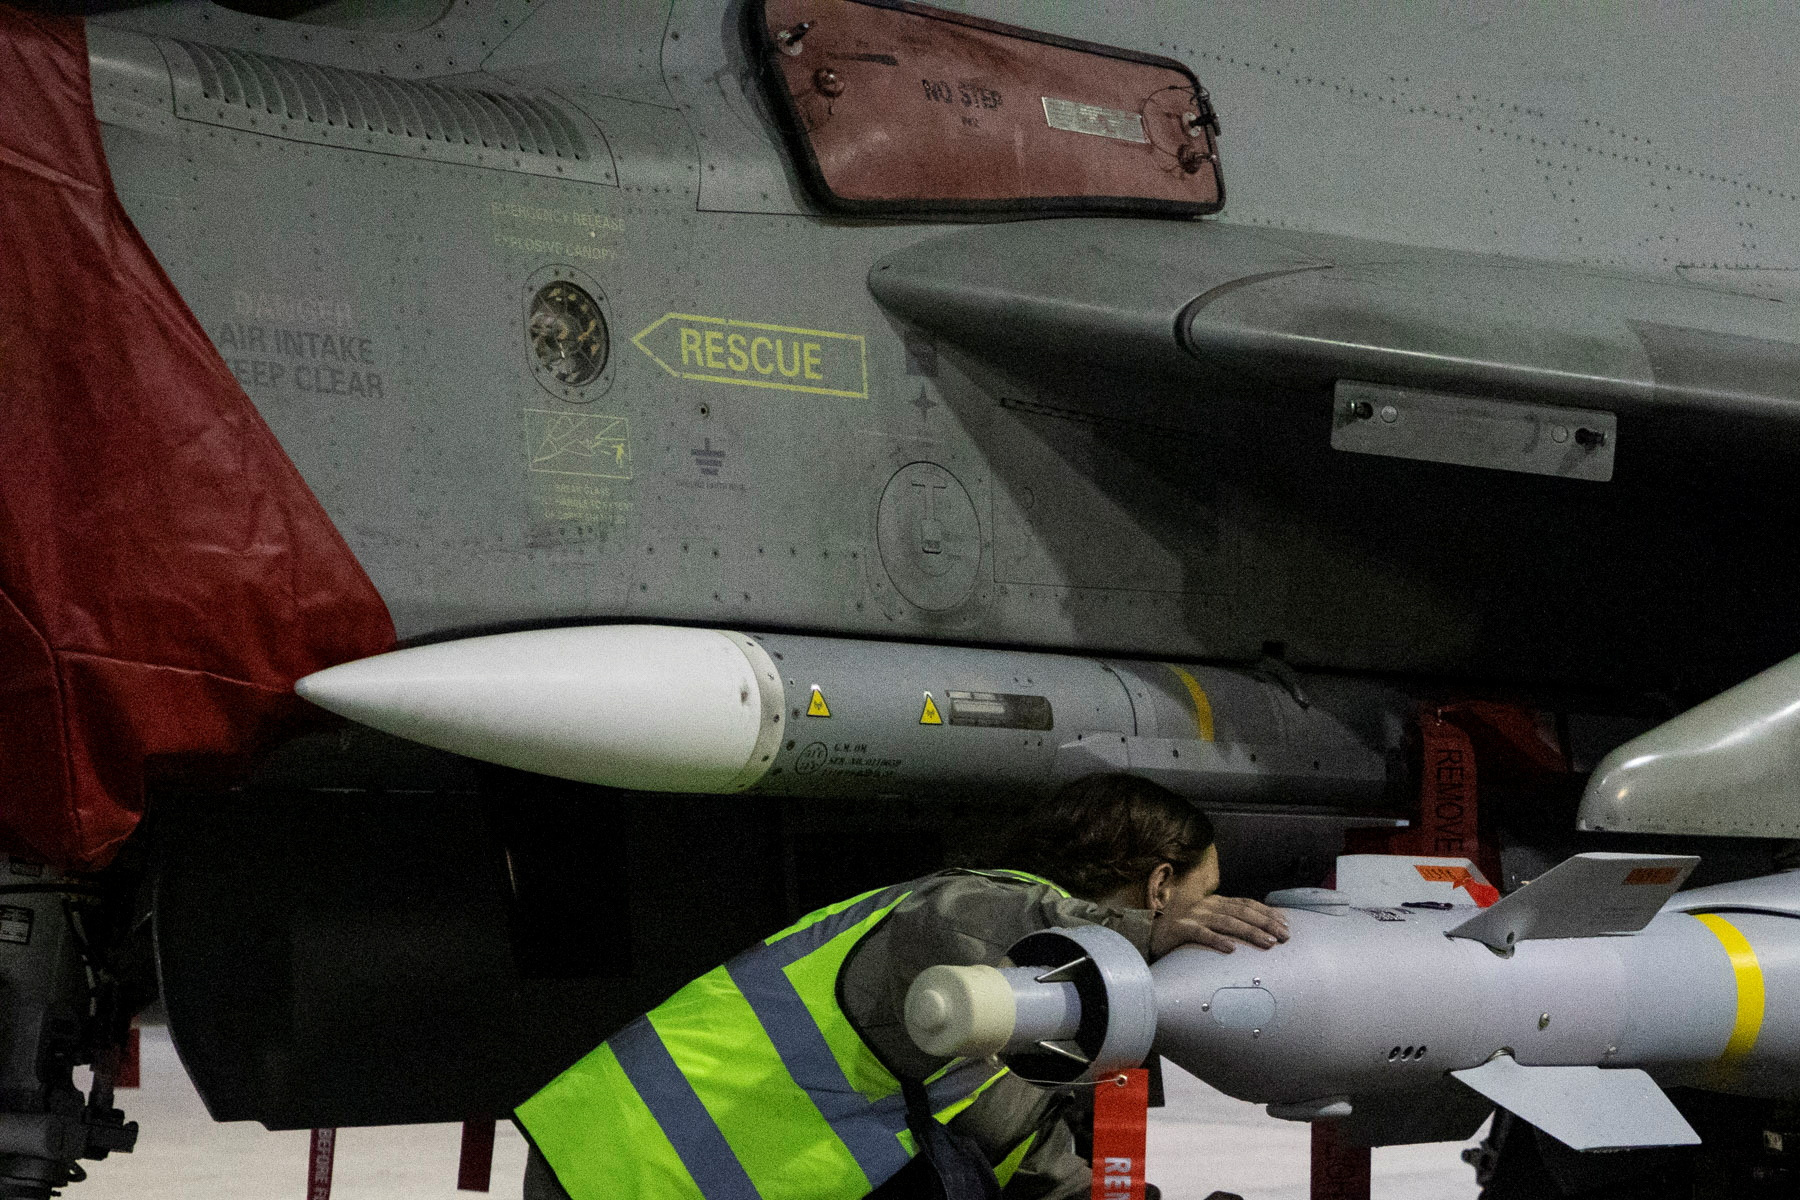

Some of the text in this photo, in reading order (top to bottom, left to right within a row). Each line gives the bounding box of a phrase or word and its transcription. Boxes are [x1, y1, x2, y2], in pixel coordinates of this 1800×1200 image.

[922, 79, 1003, 111] NO STEP
[573, 211, 626, 232] RELEASE
[232, 288, 353, 327] DANGER
[218, 321, 376, 365] AIR INTAKE
[680, 327, 823, 380] RESCUE
[227, 358, 385, 399] EEP CLEAR
[1434, 748, 1464, 852] REMOVE
[315, 1128, 333, 1185] BEFORE
